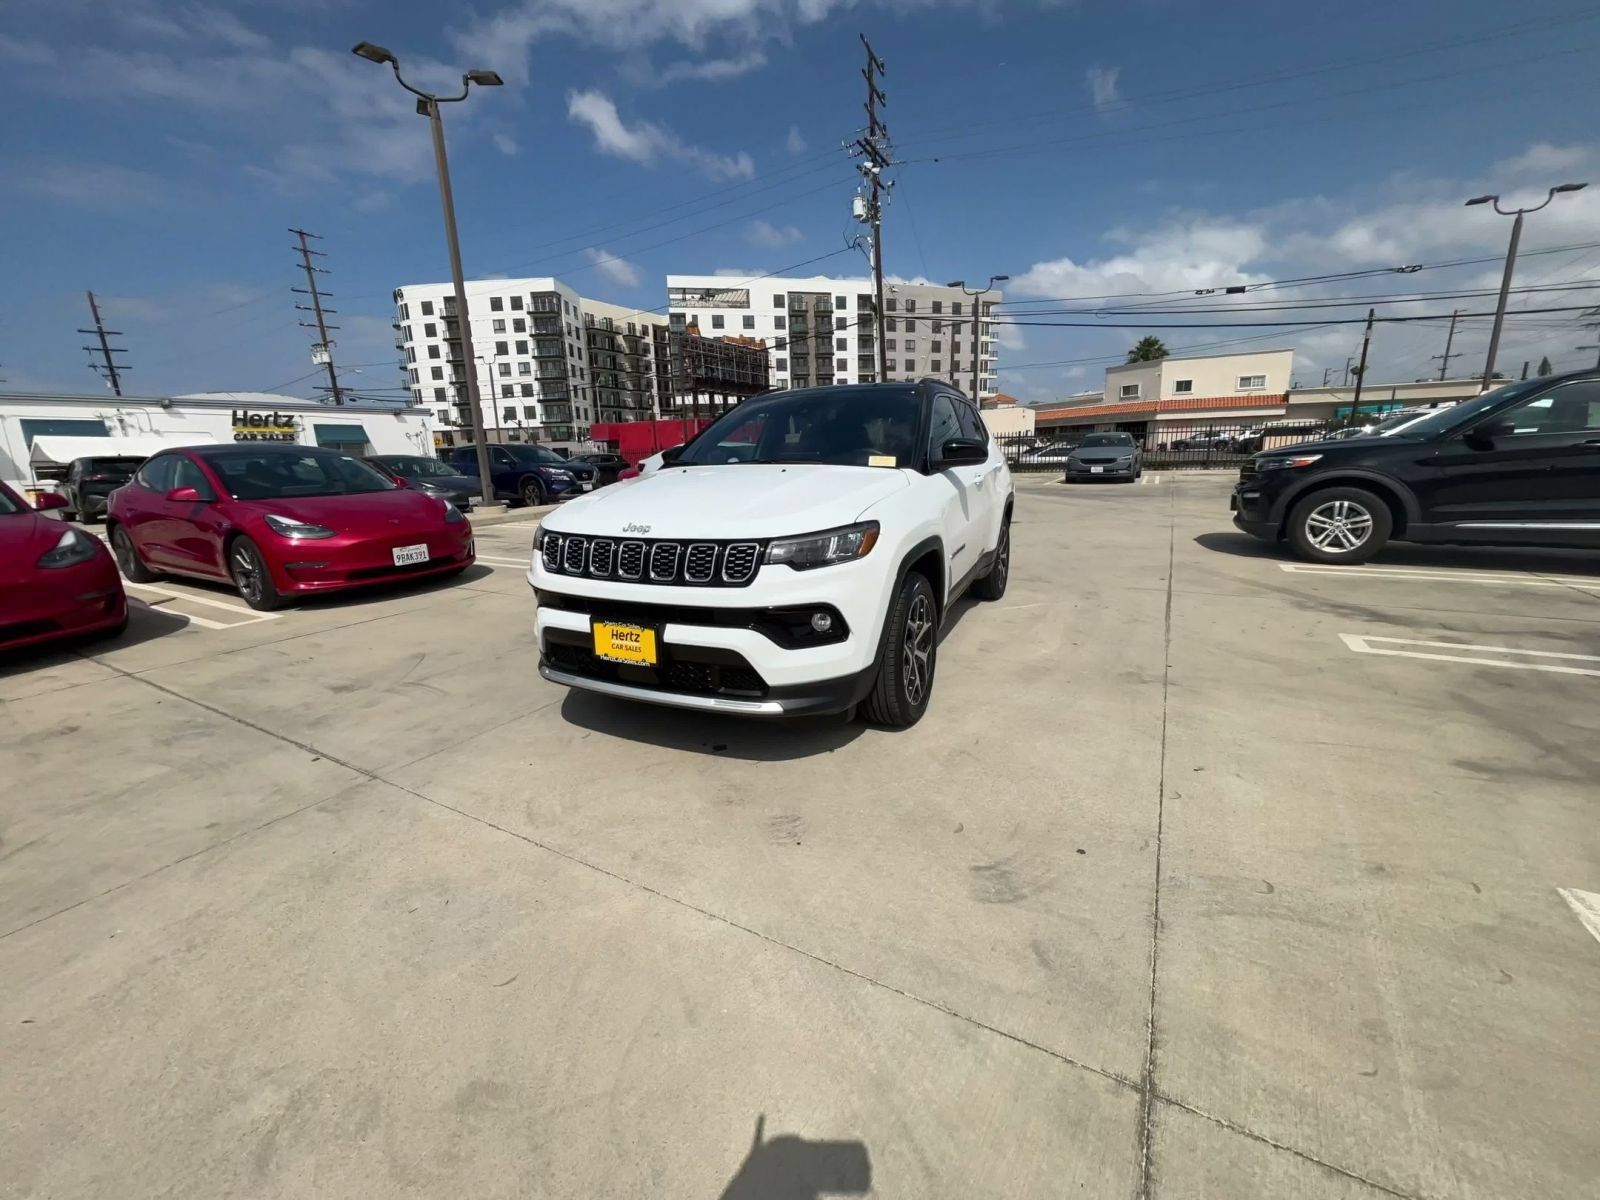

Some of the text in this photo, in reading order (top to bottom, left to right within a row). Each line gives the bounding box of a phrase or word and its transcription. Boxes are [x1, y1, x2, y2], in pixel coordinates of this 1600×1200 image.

[232, 410, 295, 428] Hertz
[233, 433, 295, 442] CAR SALES
[622, 522, 651, 535] Jeep
[396, 550, 427, 563] 9BAK391
[611, 629, 641, 643] Hertz
[611, 643, 642, 653] CAR SALES
